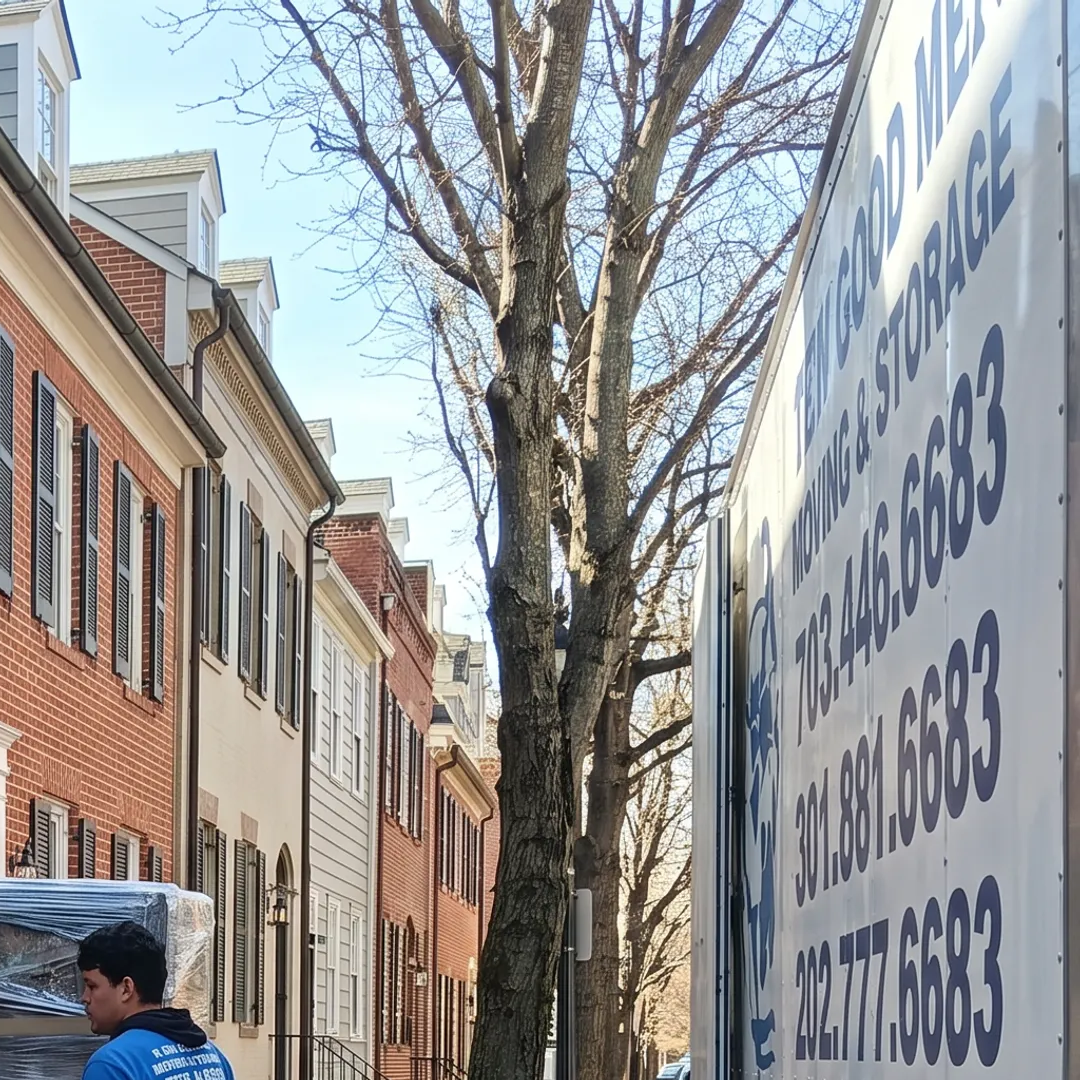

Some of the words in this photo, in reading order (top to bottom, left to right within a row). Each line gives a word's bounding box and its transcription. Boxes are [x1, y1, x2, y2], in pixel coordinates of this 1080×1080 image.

[792, 408, 850, 596] MOVING
[856, 377, 870, 475] &
[876, 62, 1015, 437] STORAGE
[836, 102, 905, 370] GOOD
[795, 323, 1007, 748] 703.446.6683
[795, 609, 1001, 908] 301.881.6683
[795, 874, 1003, 1067] 202.777.6683
